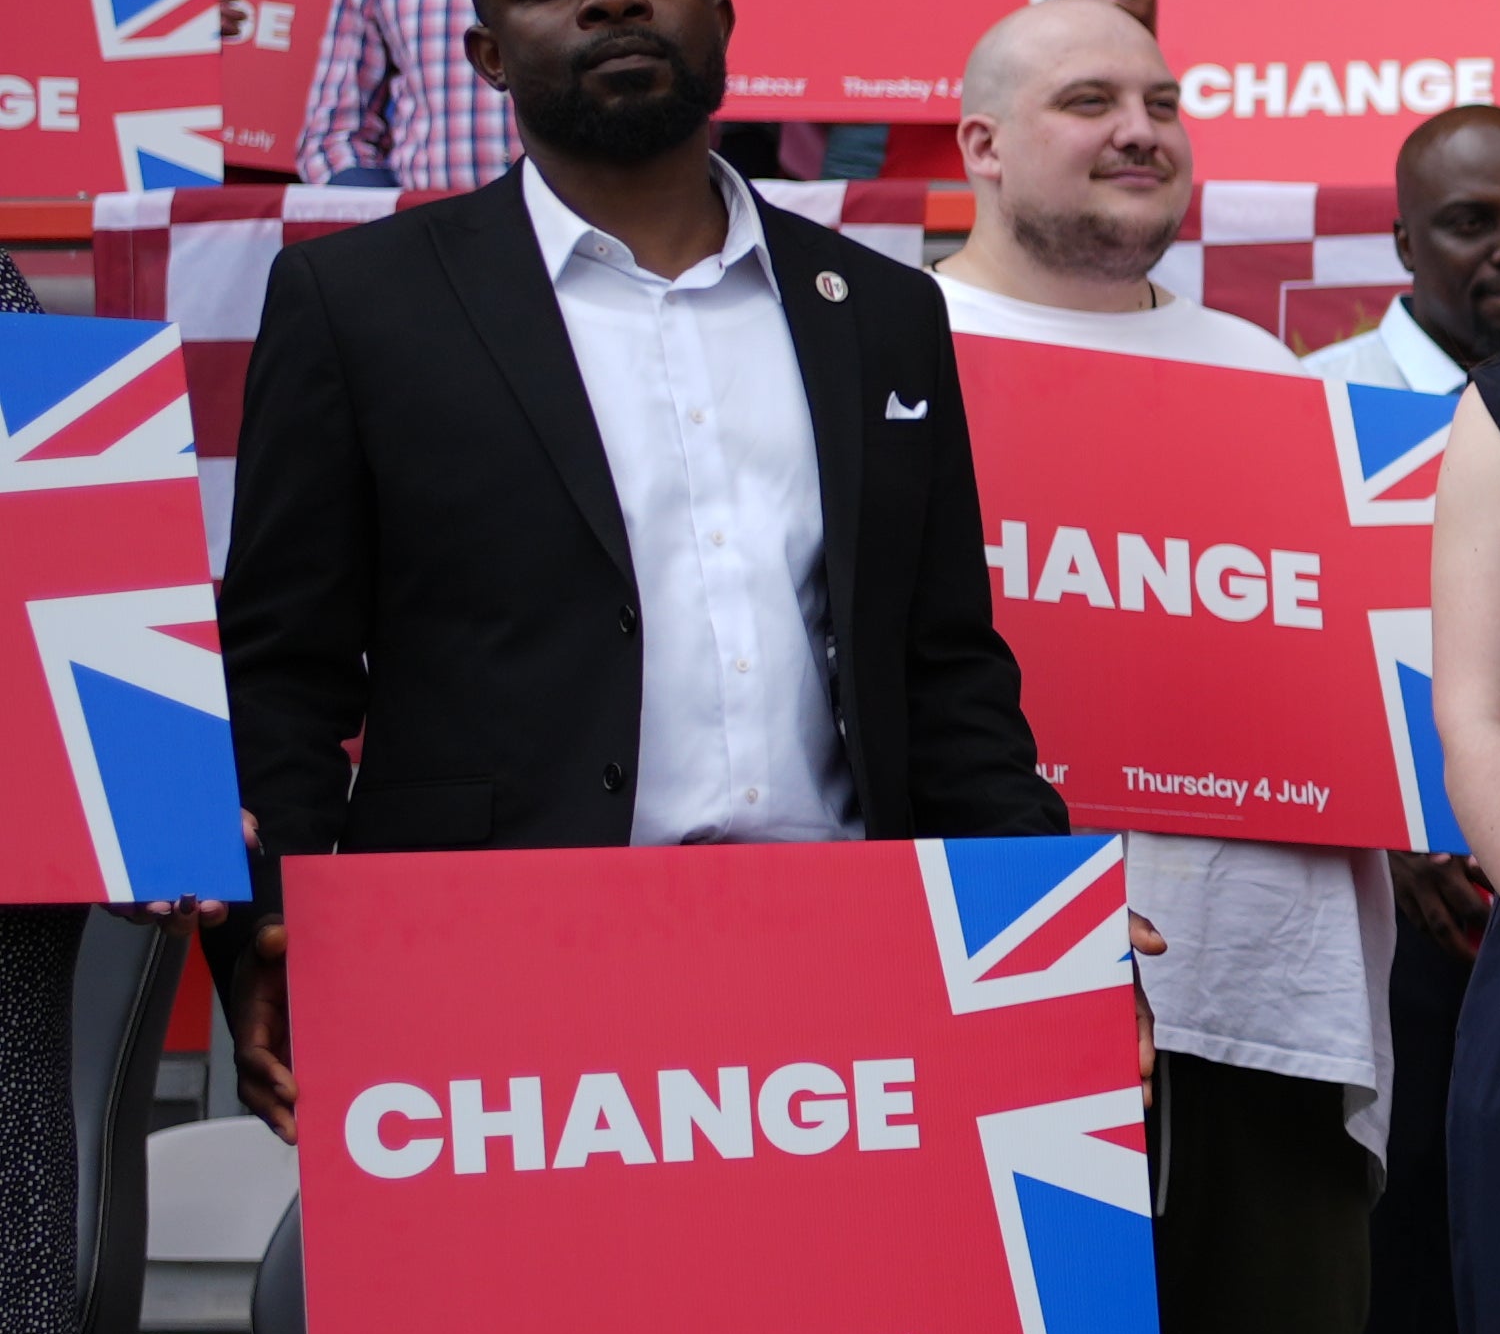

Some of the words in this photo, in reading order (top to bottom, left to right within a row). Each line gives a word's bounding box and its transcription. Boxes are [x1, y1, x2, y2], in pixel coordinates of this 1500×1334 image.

[1179, 58, 1495, 119] CHANGE
[985, 519, 1324, 630] HANGE
[1121, 766, 1249, 807] Thursday
[1253, 777, 1272, 802] 4
[1276, 779, 1330, 813] July
[344, 1057, 921, 1179] CHANGE
